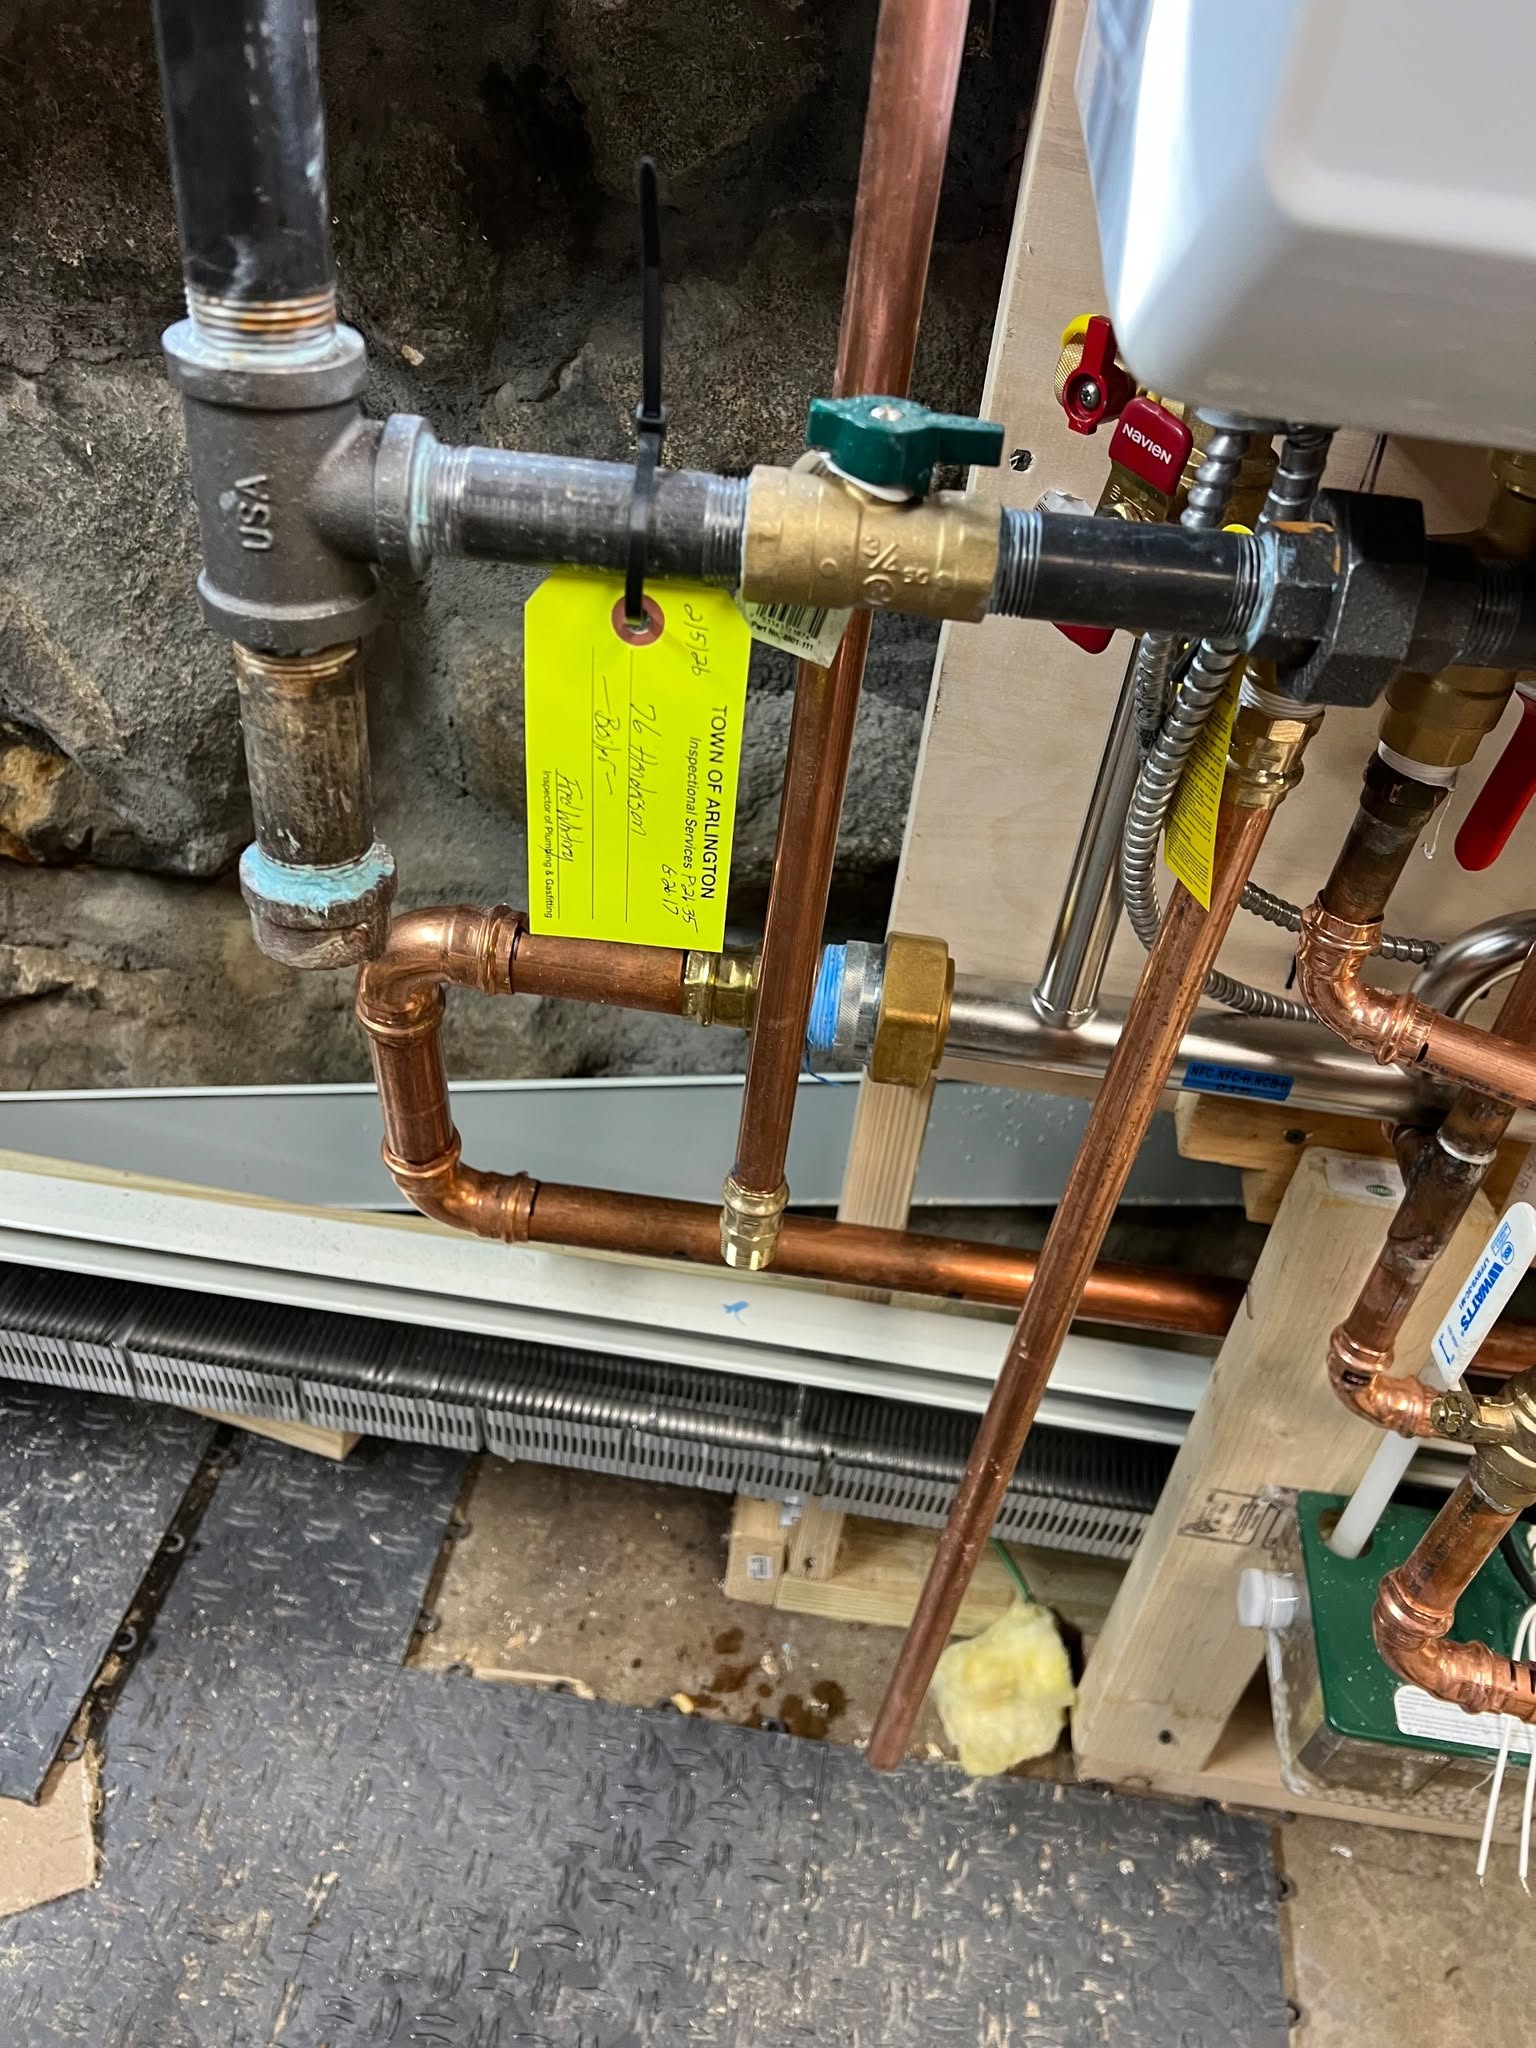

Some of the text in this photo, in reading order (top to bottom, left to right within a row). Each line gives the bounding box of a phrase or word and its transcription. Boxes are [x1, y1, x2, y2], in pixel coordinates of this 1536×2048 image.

[234, 474, 273, 549] USA
[630, 703, 662, 736] 76
[543, 770, 552, 814] Inspector
[683, 736, 701, 869] Inspectional Services
[701, 706, 727, 899] TOWN OF ARLINGTON
[544, 816, 552, 825] of
[543, 827, 553, 868] Plumbing
[544, 877, 554, 919] Gasfitting
